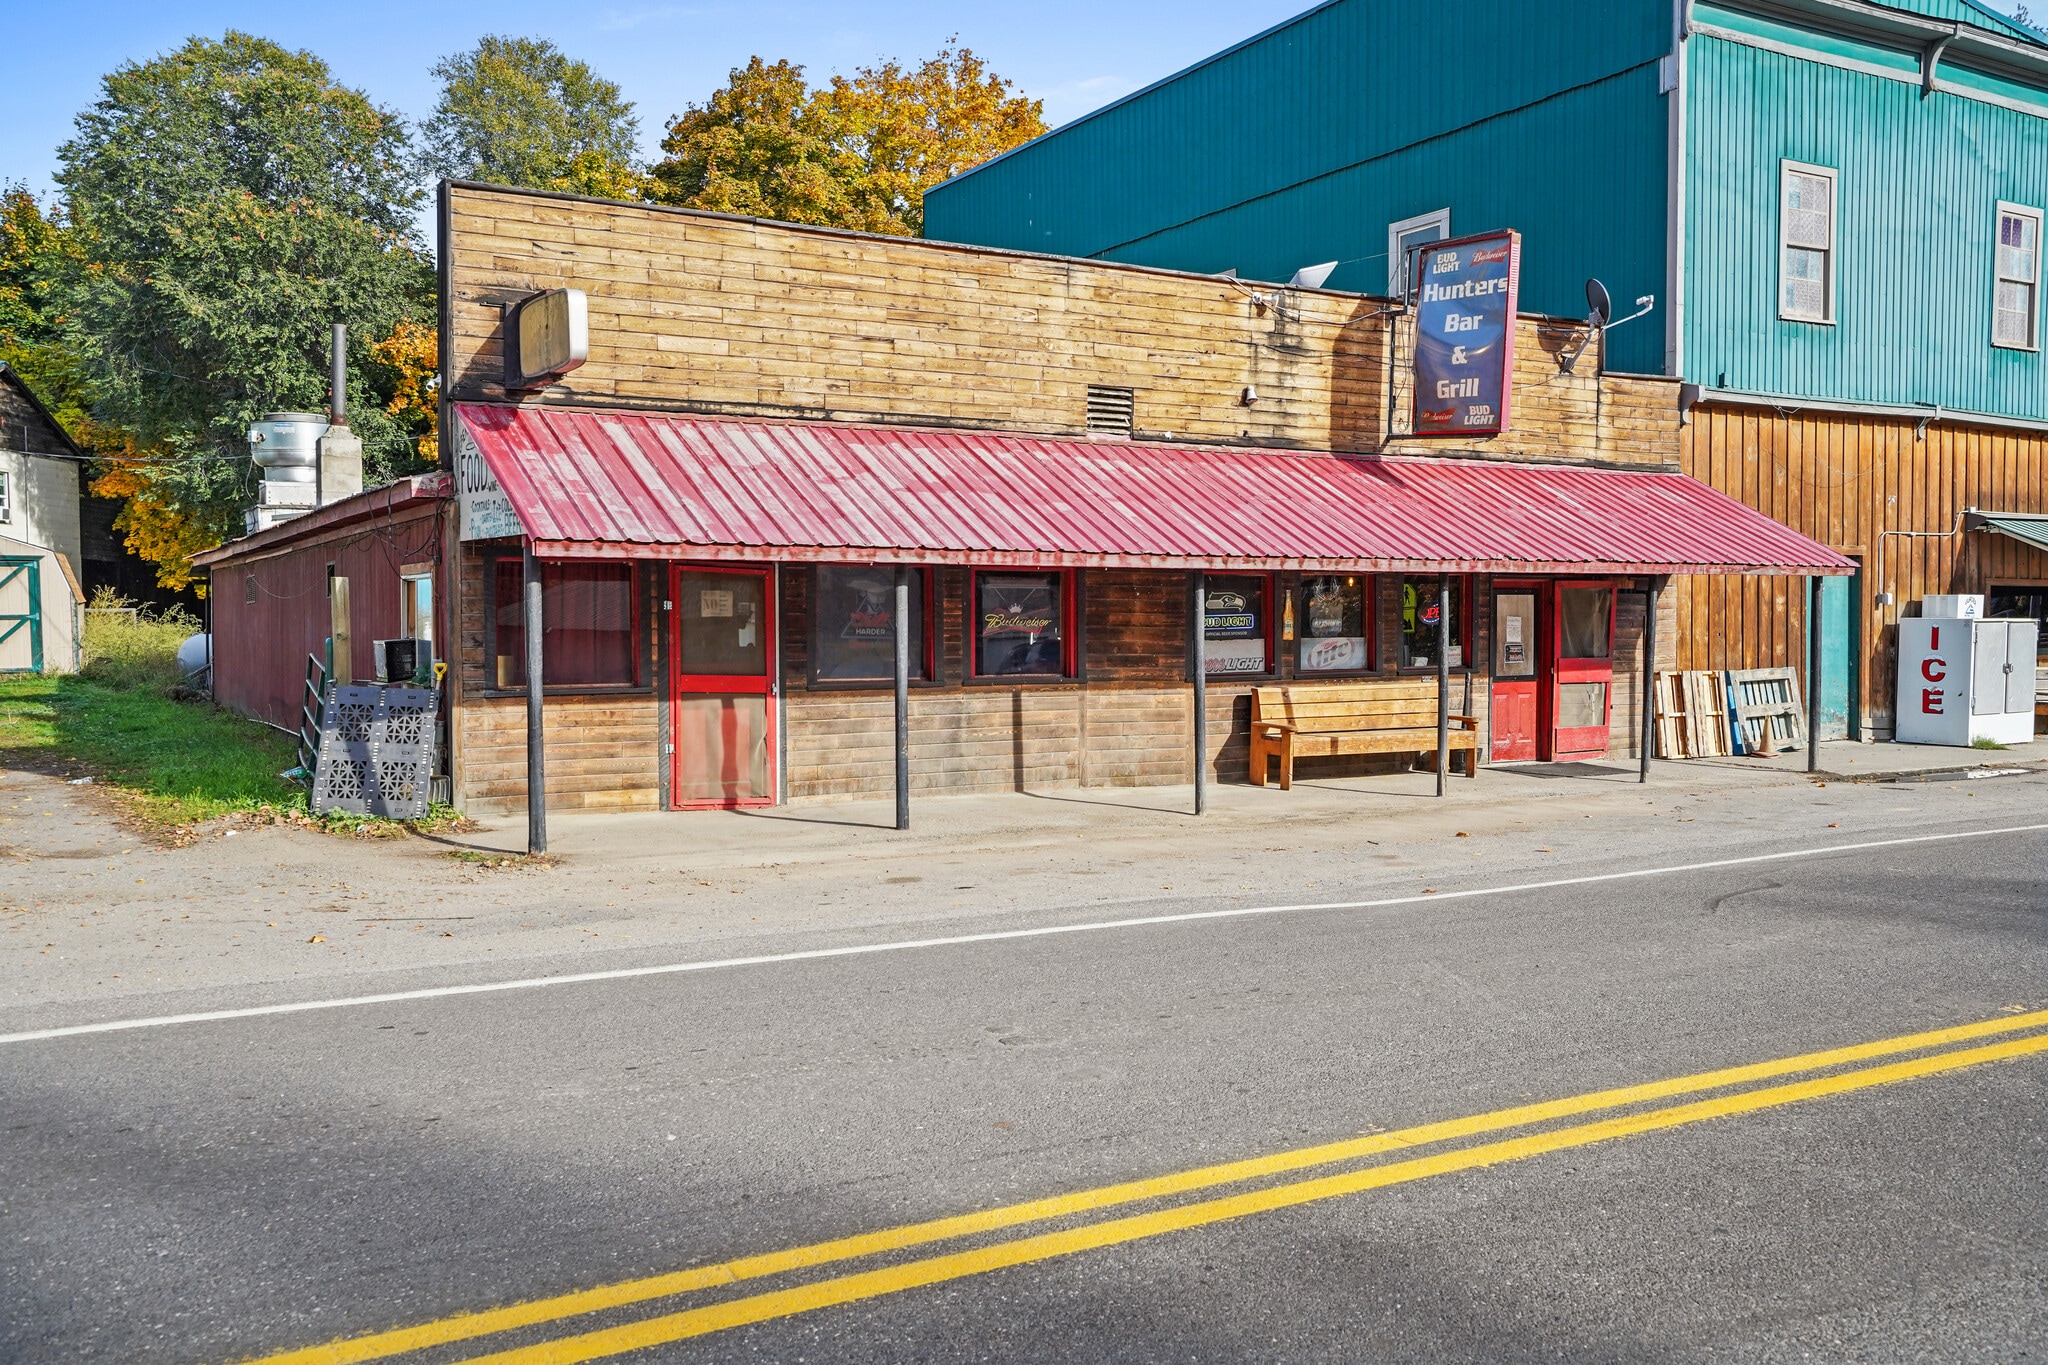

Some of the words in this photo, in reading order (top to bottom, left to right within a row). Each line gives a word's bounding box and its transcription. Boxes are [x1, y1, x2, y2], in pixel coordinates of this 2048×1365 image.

[1437, 252, 1457, 263] BUD
[1472, 249, 1508, 263] Budweiser
[1433, 260, 1460, 275] LIGHT
[1423, 277, 1508, 303] Hunters
[1444, 313, 1483, 332] Bar
[1451, 346, 1467, 365] &
[1436, 378, 1479, 399] Grill
[1469, 405, 1490, 416] BUD
[1464, 414, 1495, 426] LIGHT
[460, 453, 488, 494] FOOD
[985, 614, 1052, 627] Budweiser
[1204, 617, 1221, 627] UD
[1222, 616, 1252, 627] LIGHT
[1224, 656, 1263, 671] LIGHT
[1921, 624, 1947, 714] ICE
